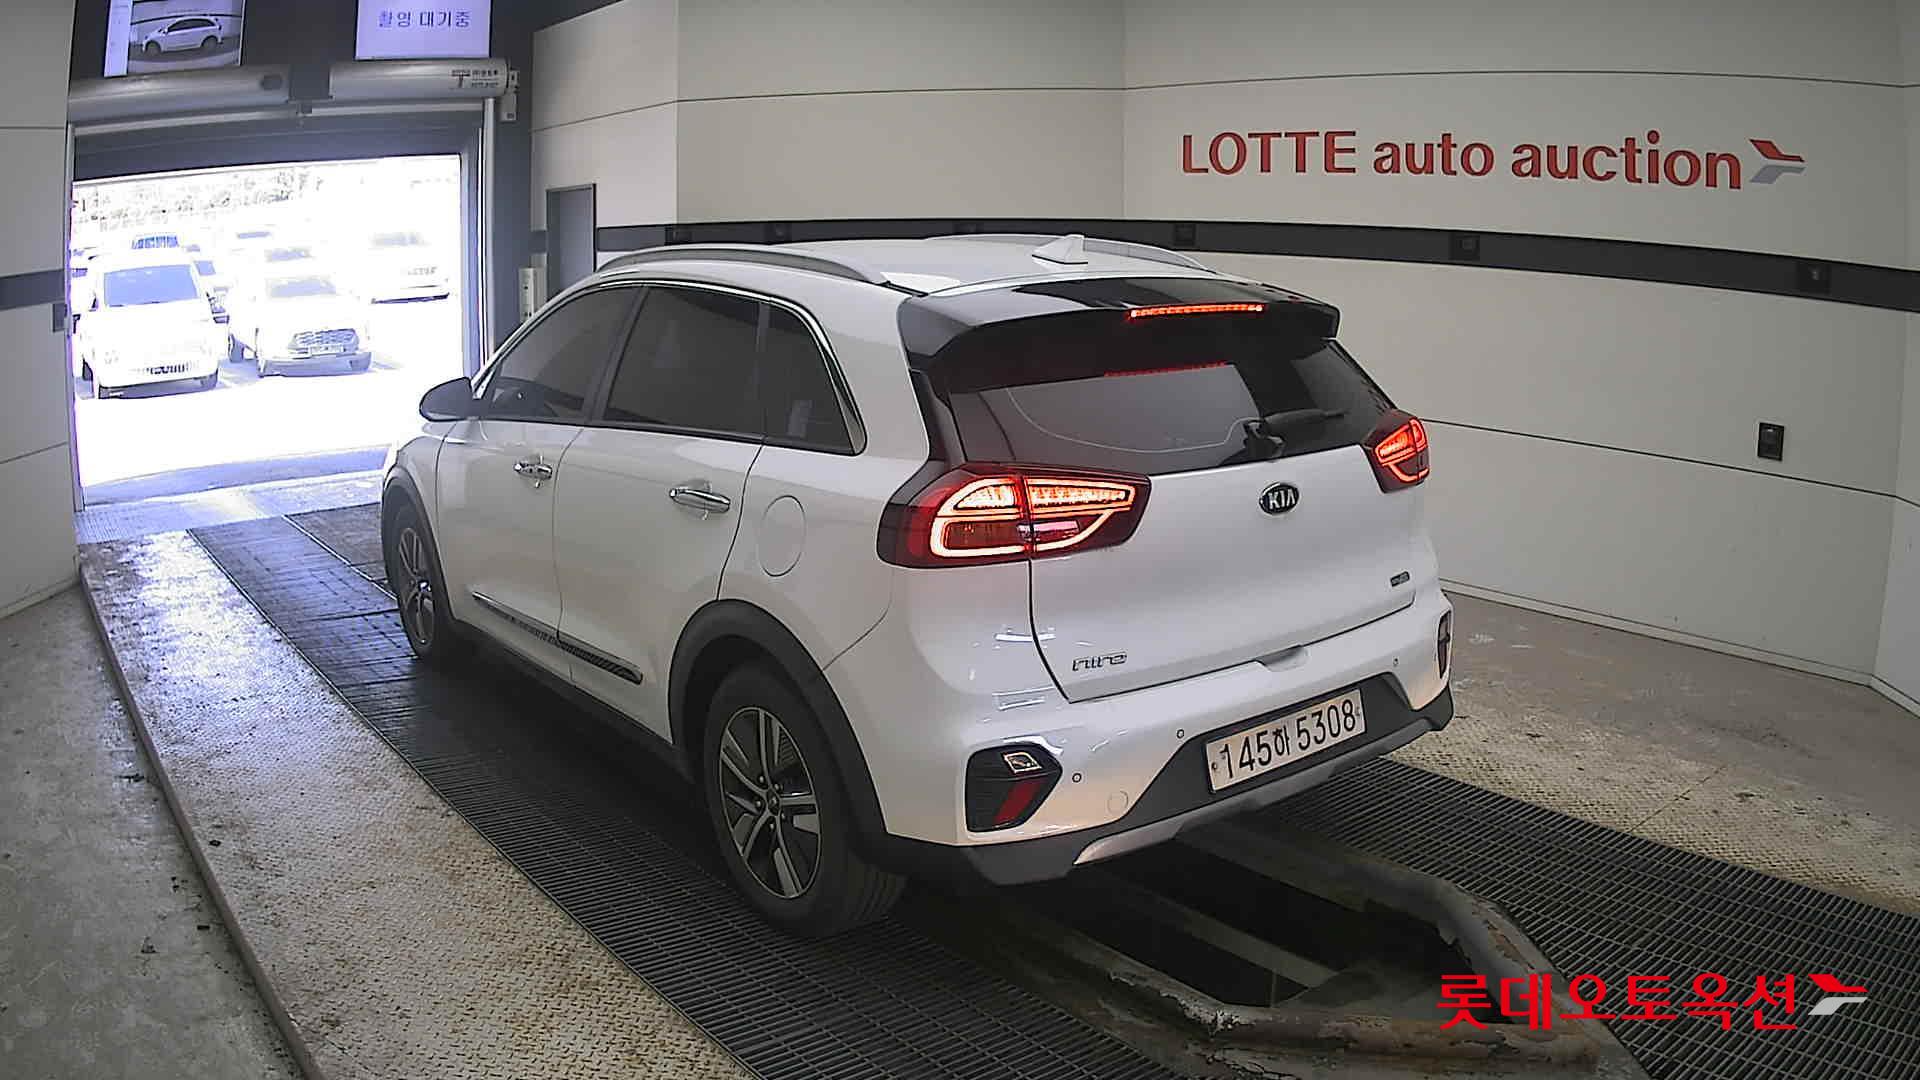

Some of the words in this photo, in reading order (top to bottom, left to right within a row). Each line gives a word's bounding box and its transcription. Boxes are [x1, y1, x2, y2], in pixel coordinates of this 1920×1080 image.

[419, 10, 470, 28] 대기중
[1181, 130, 1357, 175] LOTTE
[1373, 132, 1495, 178] auto
[1511, 129, 1742, 190] auction
[1267, 488, 1296, 510] KIA
[1219, 724, 1290, 779] 145하
[1296, 699, 1357, 751] 5308
